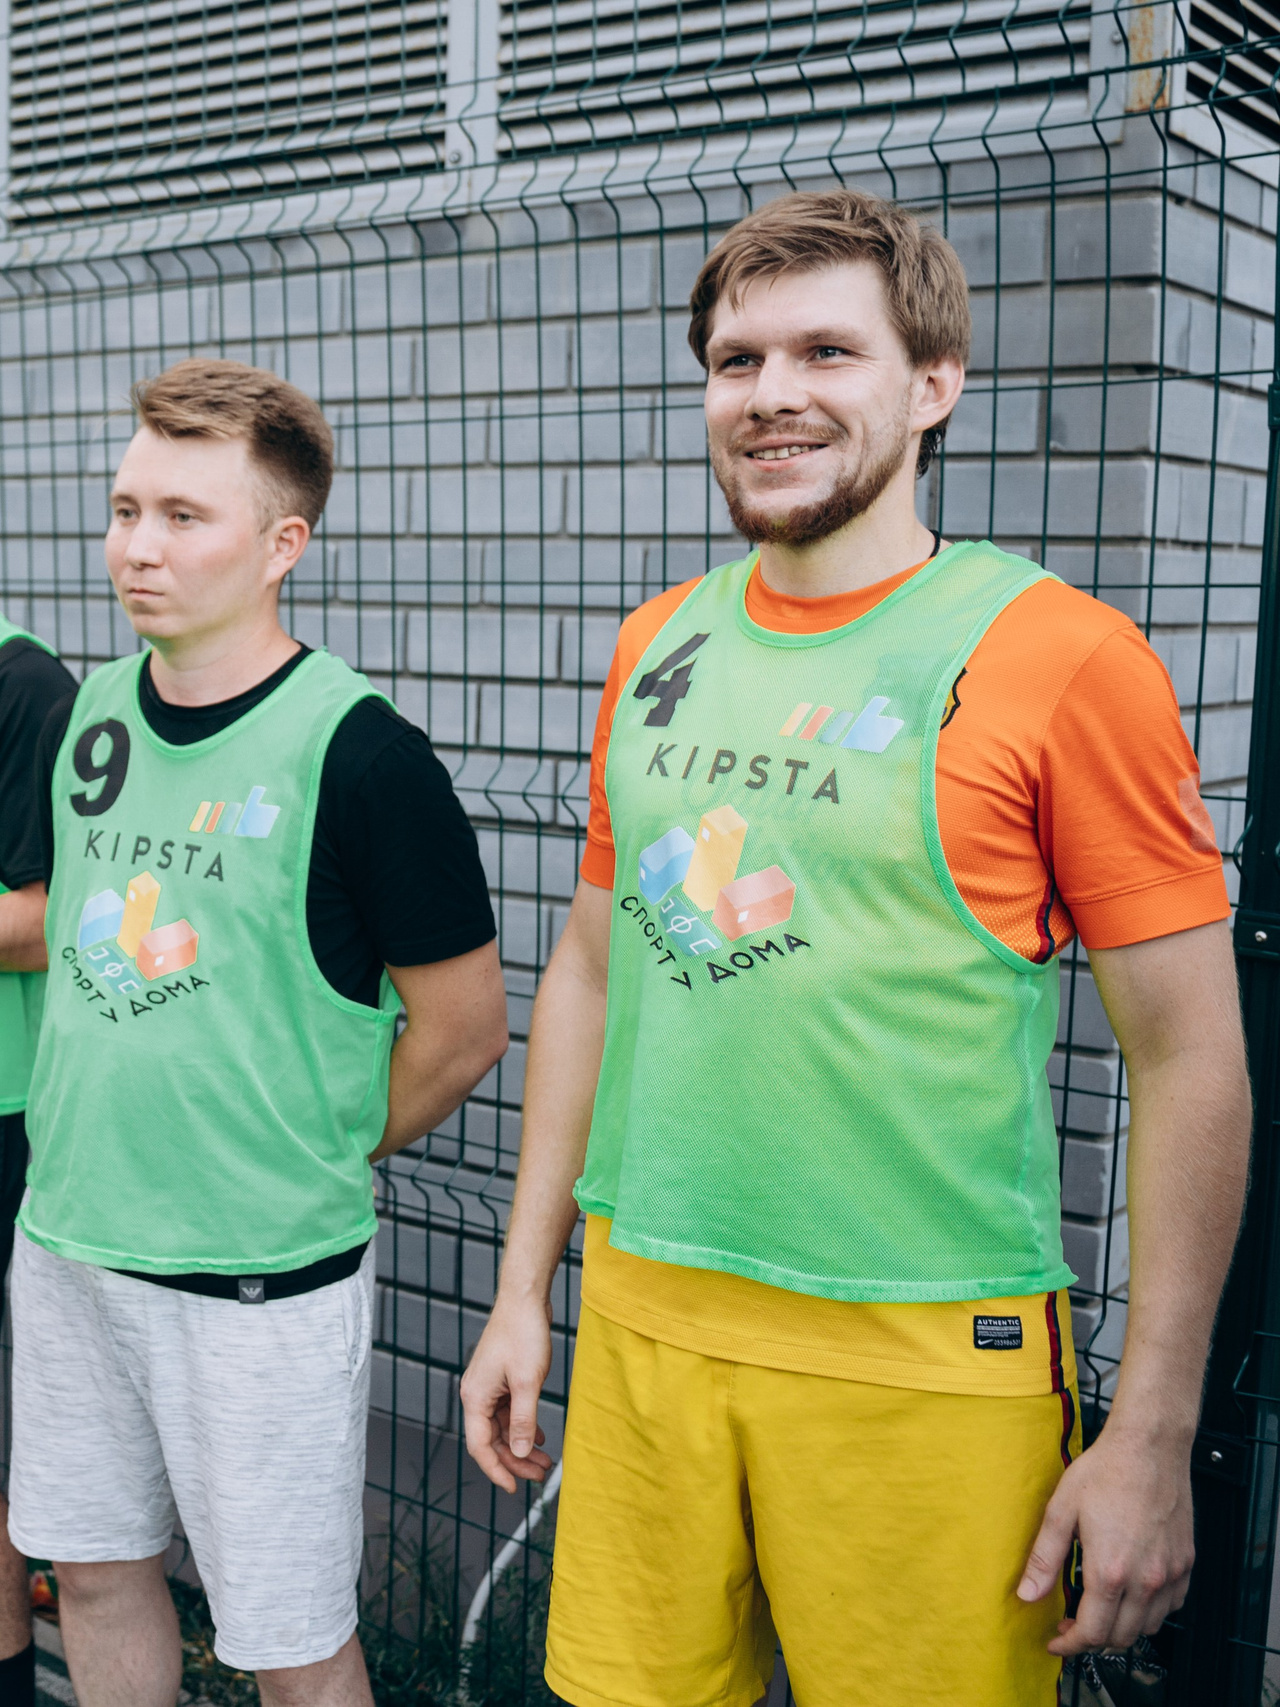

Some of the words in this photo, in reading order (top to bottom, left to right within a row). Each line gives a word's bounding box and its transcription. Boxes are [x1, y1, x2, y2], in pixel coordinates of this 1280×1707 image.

[633, 632, 711, 726] 4
[70, 718, 130, 816] 9
[645, 742, 840, 804] KIPSTA
[84, 829, 224, 882] KIPSTA
[620, 896, 676, 965] СПОРТ
[670, 971, 693, 991] У
[706, 933, 811, 984] ДОМА
[99, 1007, 118, 1023] У
[130, 974, 210, 1017] ДОМА
[977, 1318, 1020, 1326] AUTHENTIC
